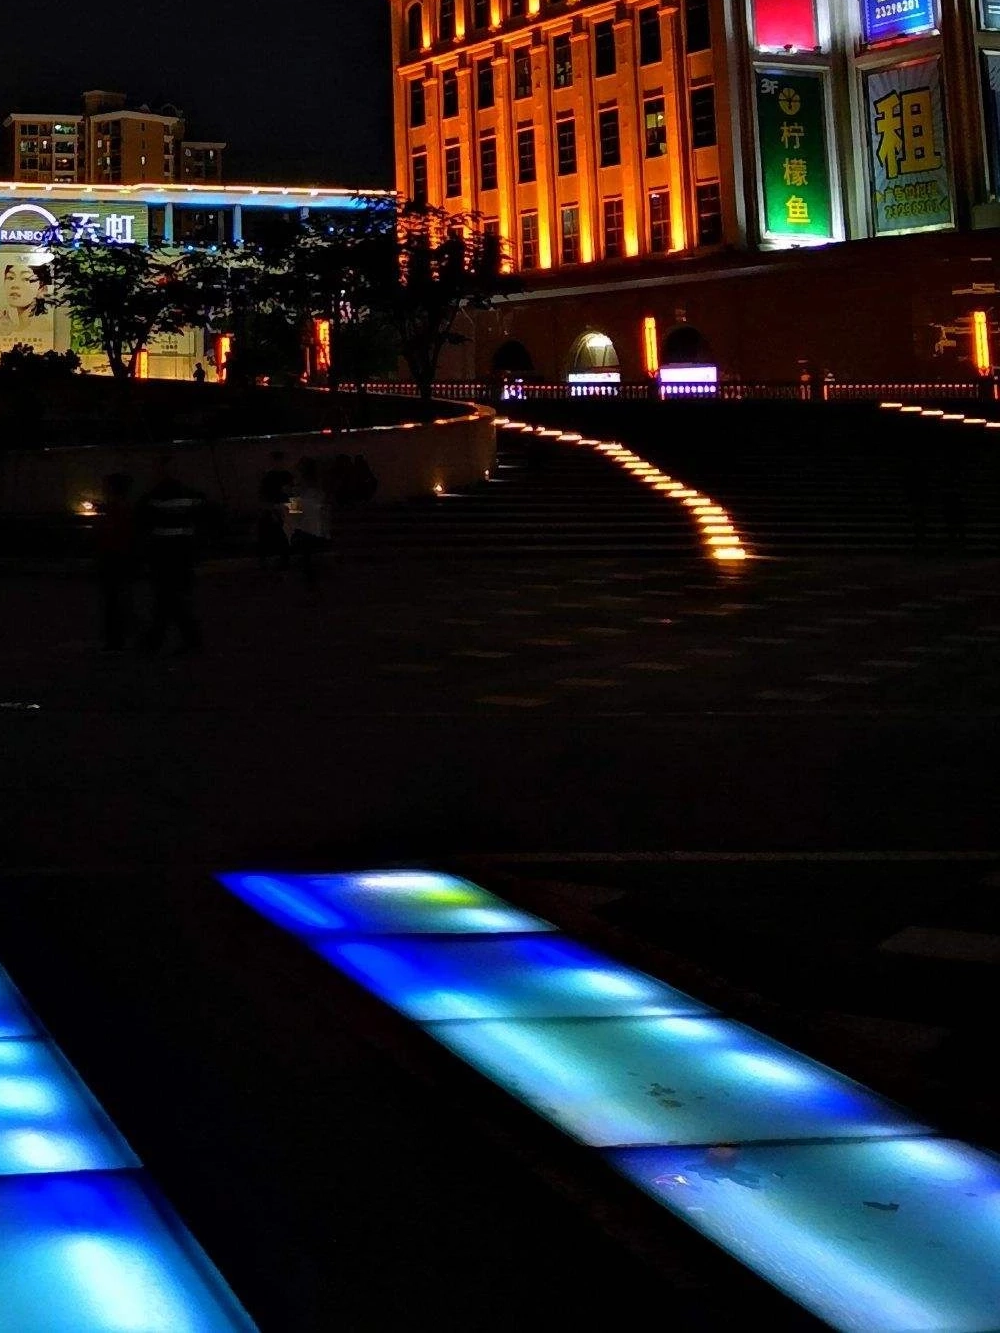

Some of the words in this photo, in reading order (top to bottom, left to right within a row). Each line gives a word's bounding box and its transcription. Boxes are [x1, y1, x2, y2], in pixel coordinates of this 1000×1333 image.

[760, 78, 779, 95] 3F
[873, 86, 943, 179] 租
[780, 121, 811, 224] 柠檬鱼
[71, 213, 135, 244] 天虹
